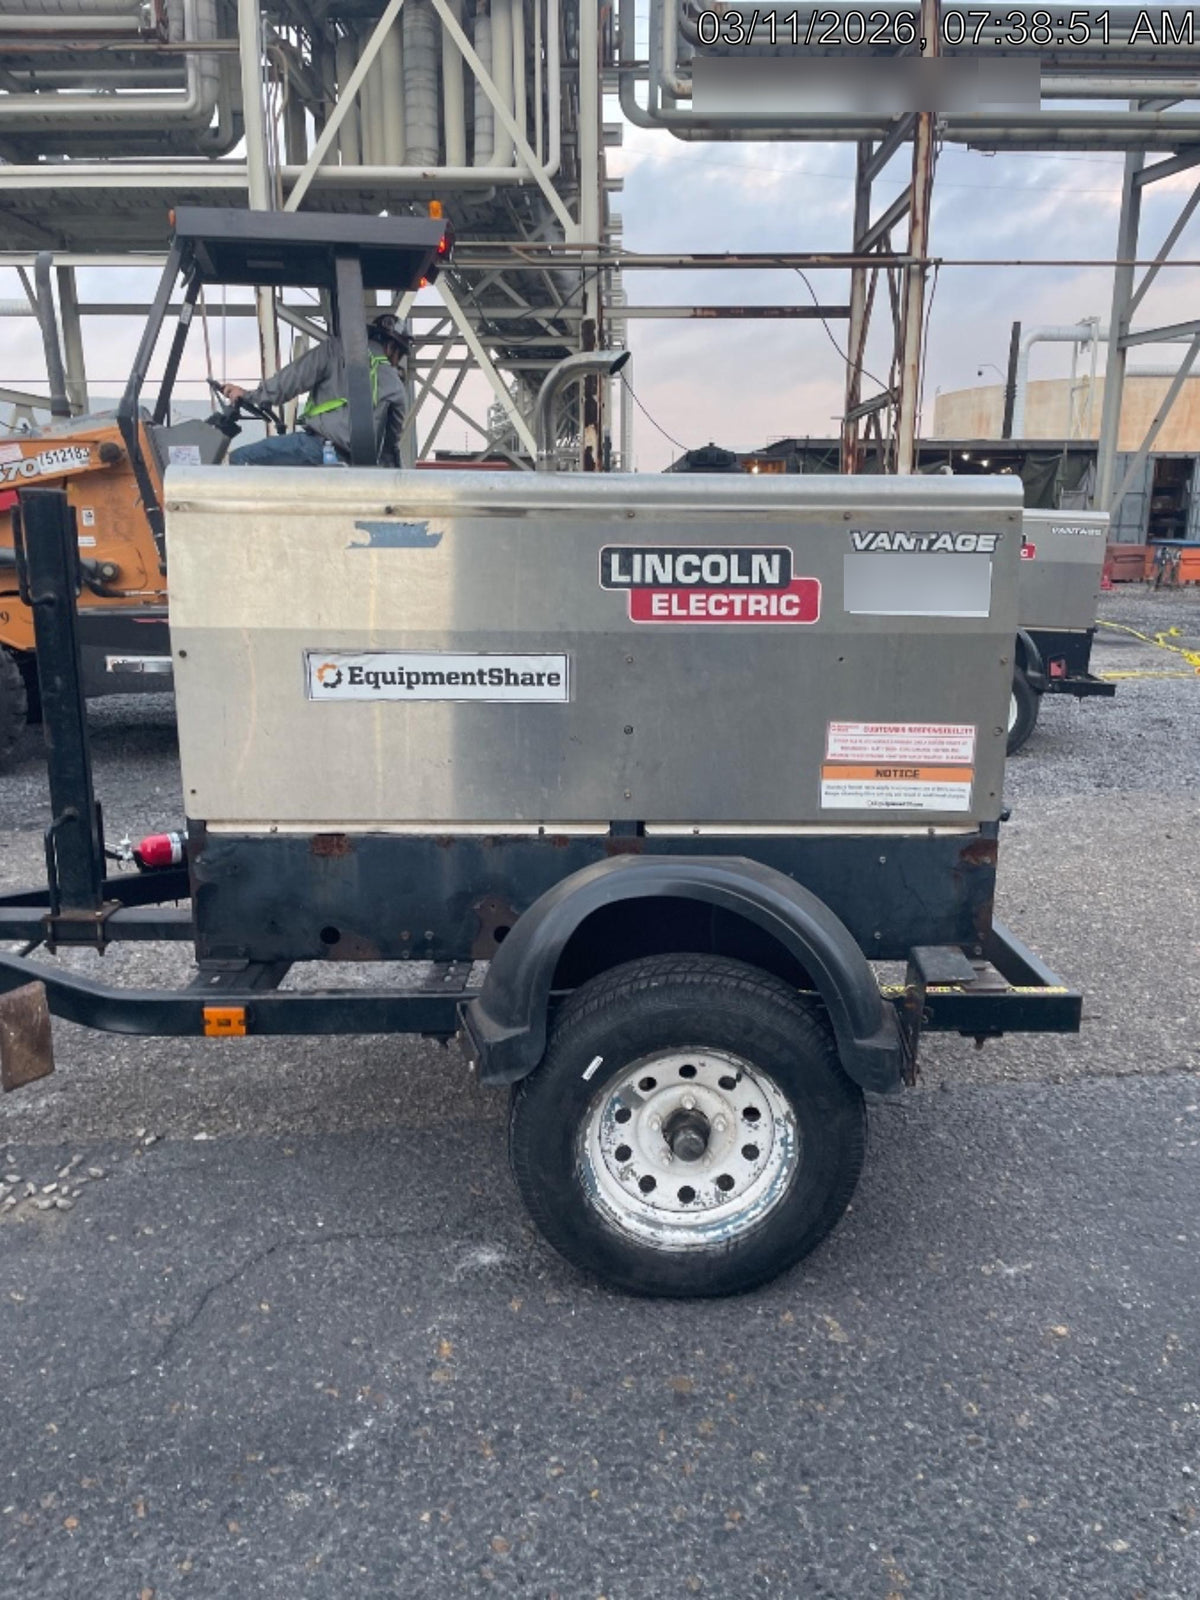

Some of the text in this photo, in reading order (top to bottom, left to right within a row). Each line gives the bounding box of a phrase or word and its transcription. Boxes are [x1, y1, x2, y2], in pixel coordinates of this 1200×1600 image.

[850, 531, 998, 553] VANTAGE
[610, 553, 781, 584] LINCOLN
[651, 593, 801, 616] ELECTRIC
[347, 665, 561, 690] EquipmentShare
[875, 769, 920, 778] NOTICE
